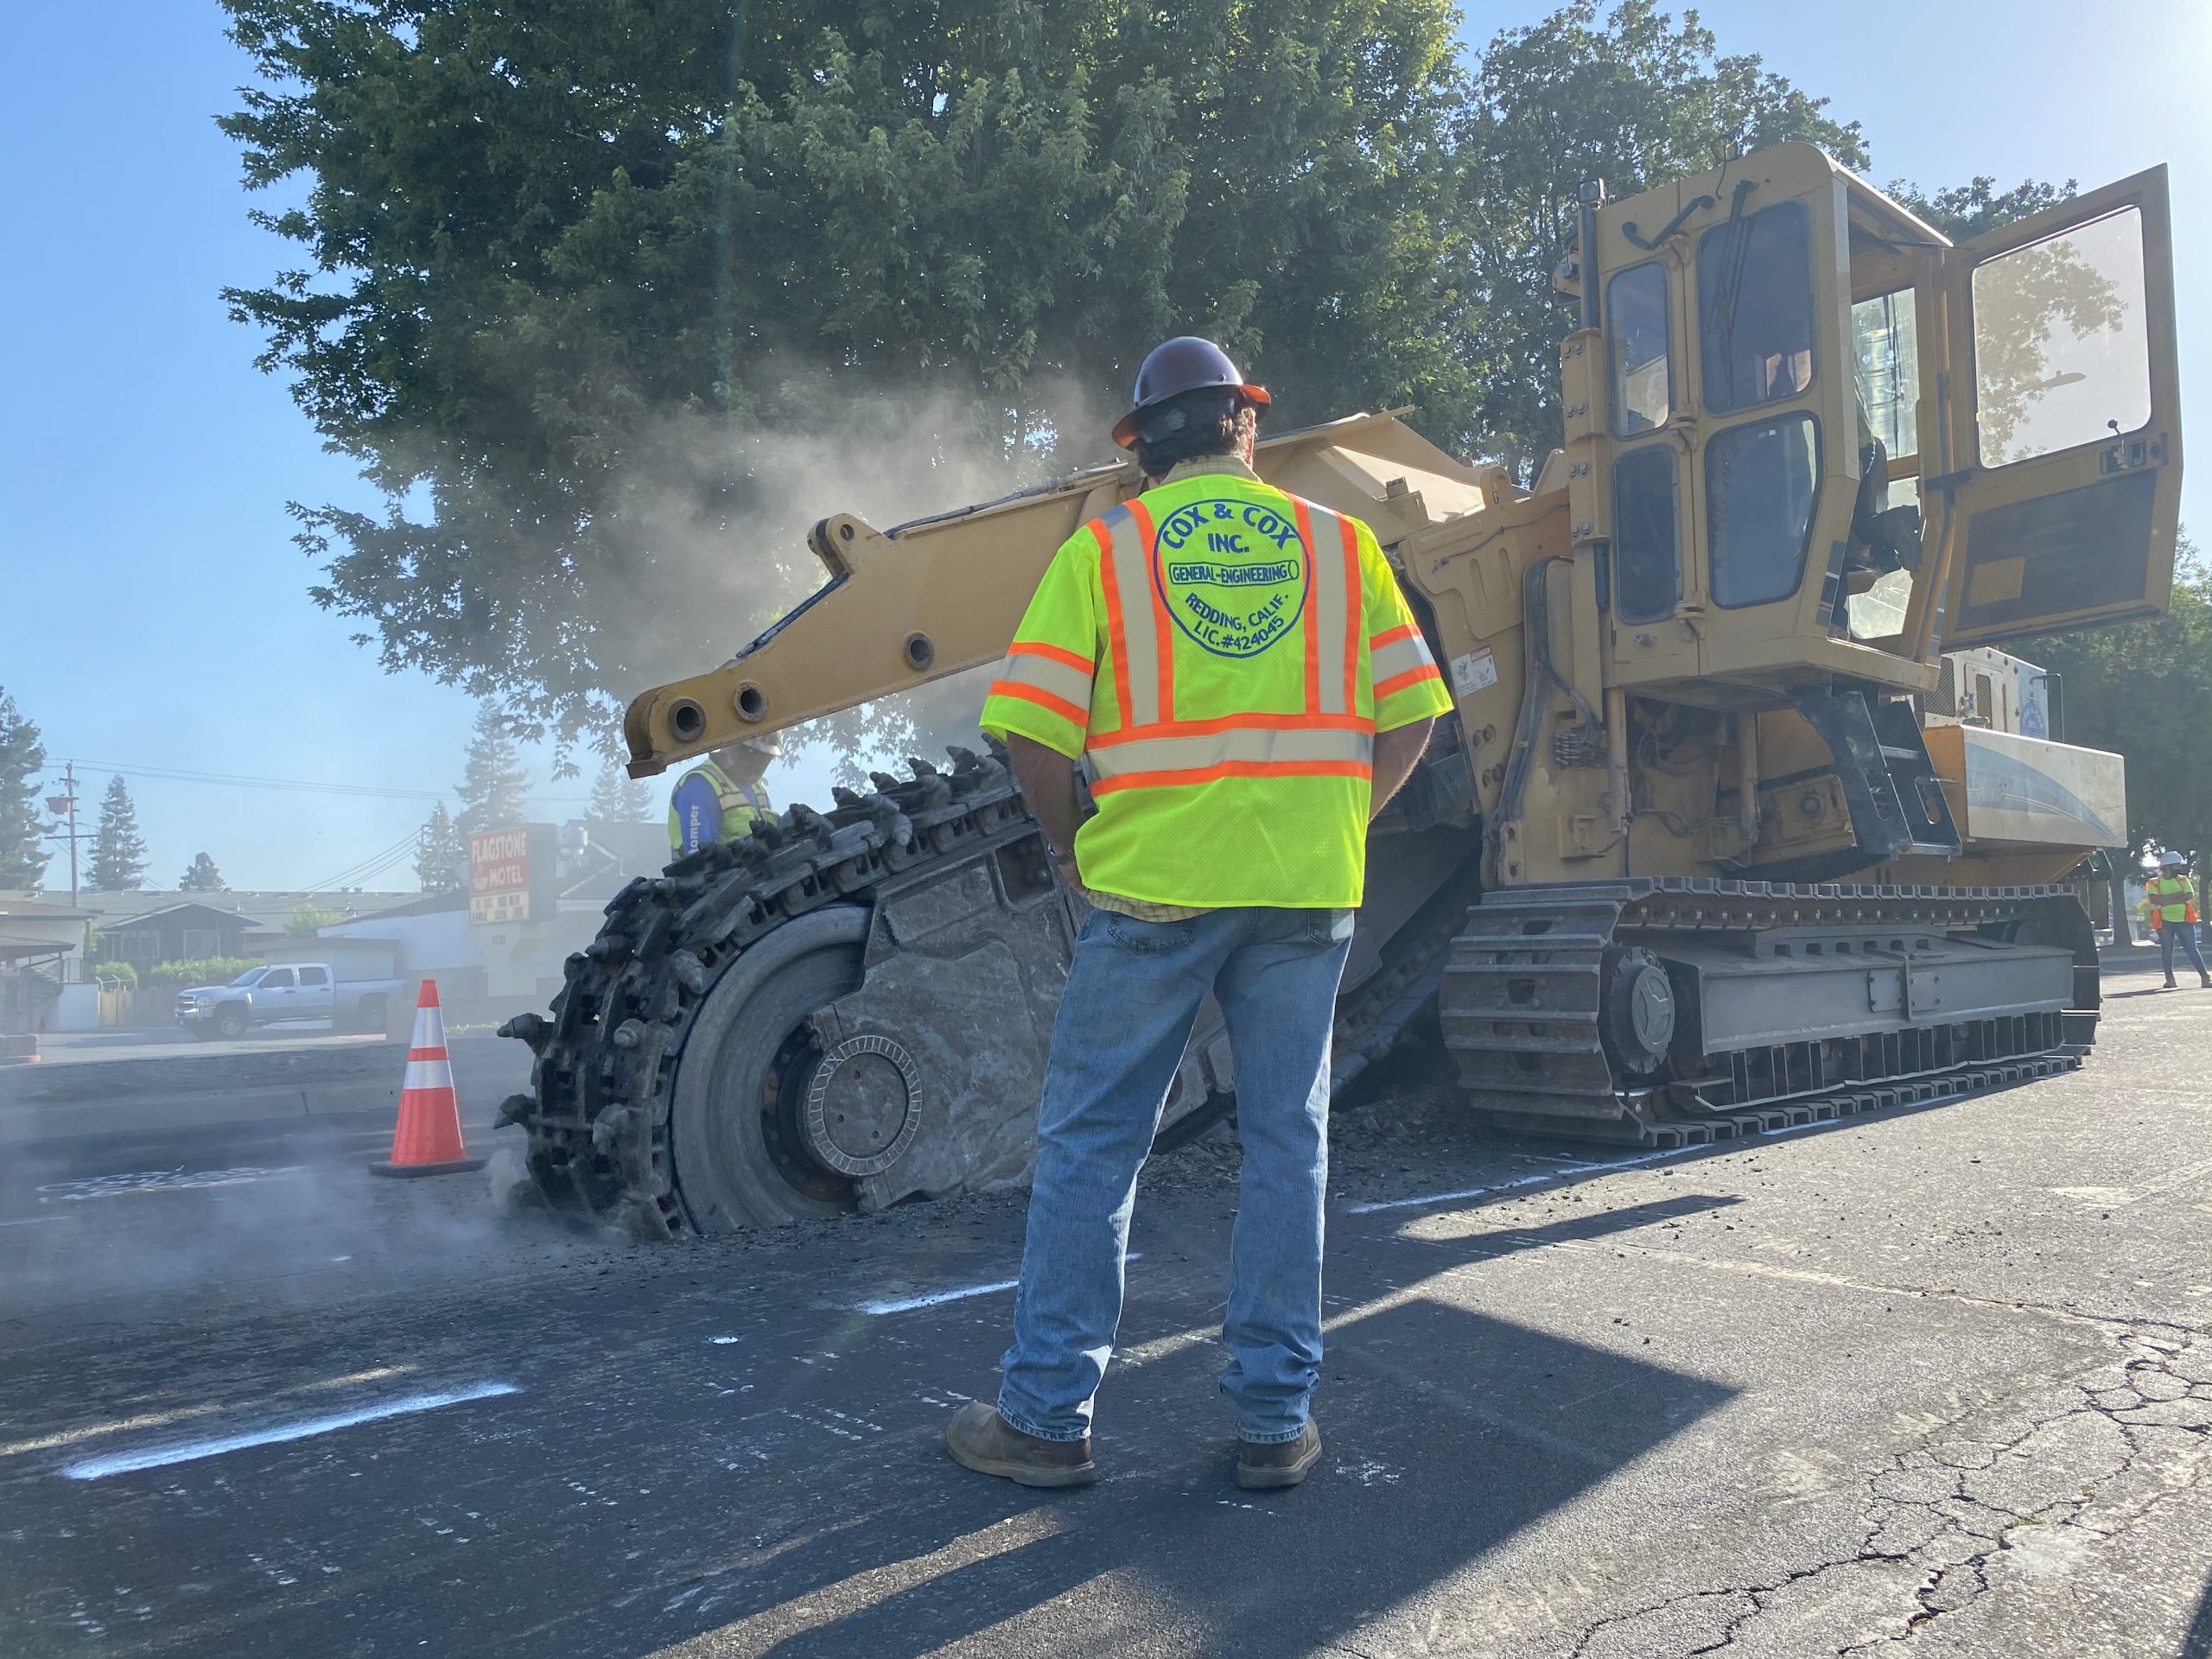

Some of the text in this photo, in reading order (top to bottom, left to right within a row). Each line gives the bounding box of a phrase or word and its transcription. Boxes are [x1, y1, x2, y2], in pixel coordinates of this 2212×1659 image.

[1162, 503, 1297, 550] COX & COX
[1207, 532, 1250, 553] INC.
[1172, 564, 1287, 583] GENERAL-ENGINEERING
[1185, 593, 1289, 632] REDDING, CALIF.
[472, 832, 527, 863] FLAGSTONE
[489, 864, 523, 887] MOTEL
